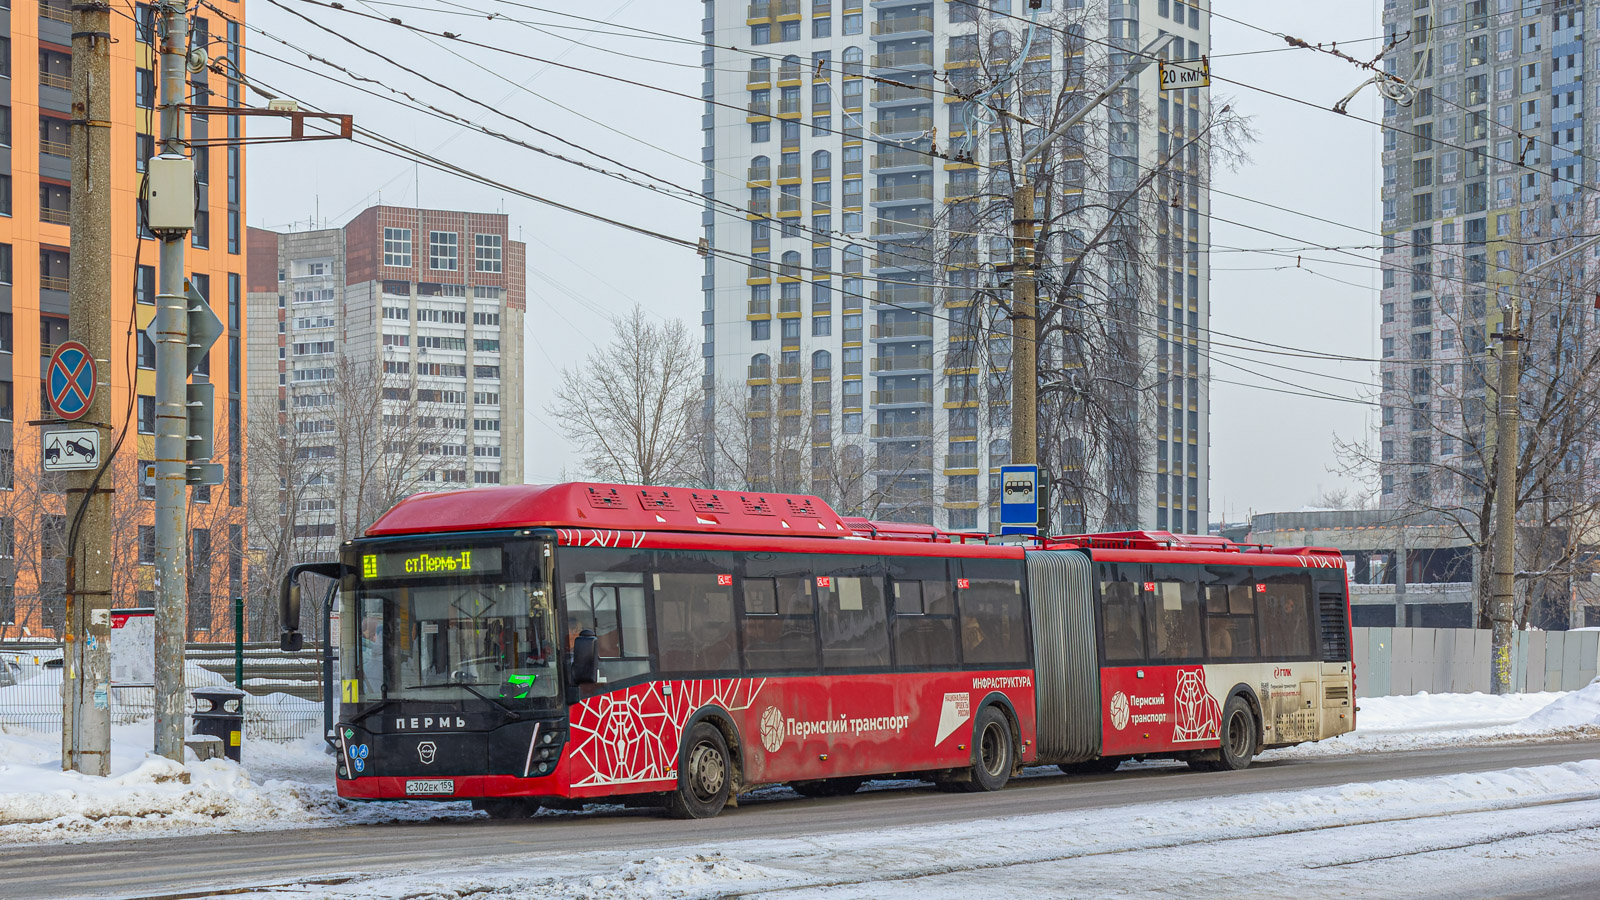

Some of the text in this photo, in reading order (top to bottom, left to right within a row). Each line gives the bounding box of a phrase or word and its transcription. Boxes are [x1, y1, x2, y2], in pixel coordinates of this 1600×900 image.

[1162, 70, 1176, 84] 20
[972, 677, 1031, 689] ИНФРАСТРУКТУРА
[1130, 693, 1165, 708] Пермский
[396, 717, 466, 729] ПЕРМЬ
[1131, 713, 1167, 726] транспорт
[787, 714, 909, 739] Пермский транспорт
